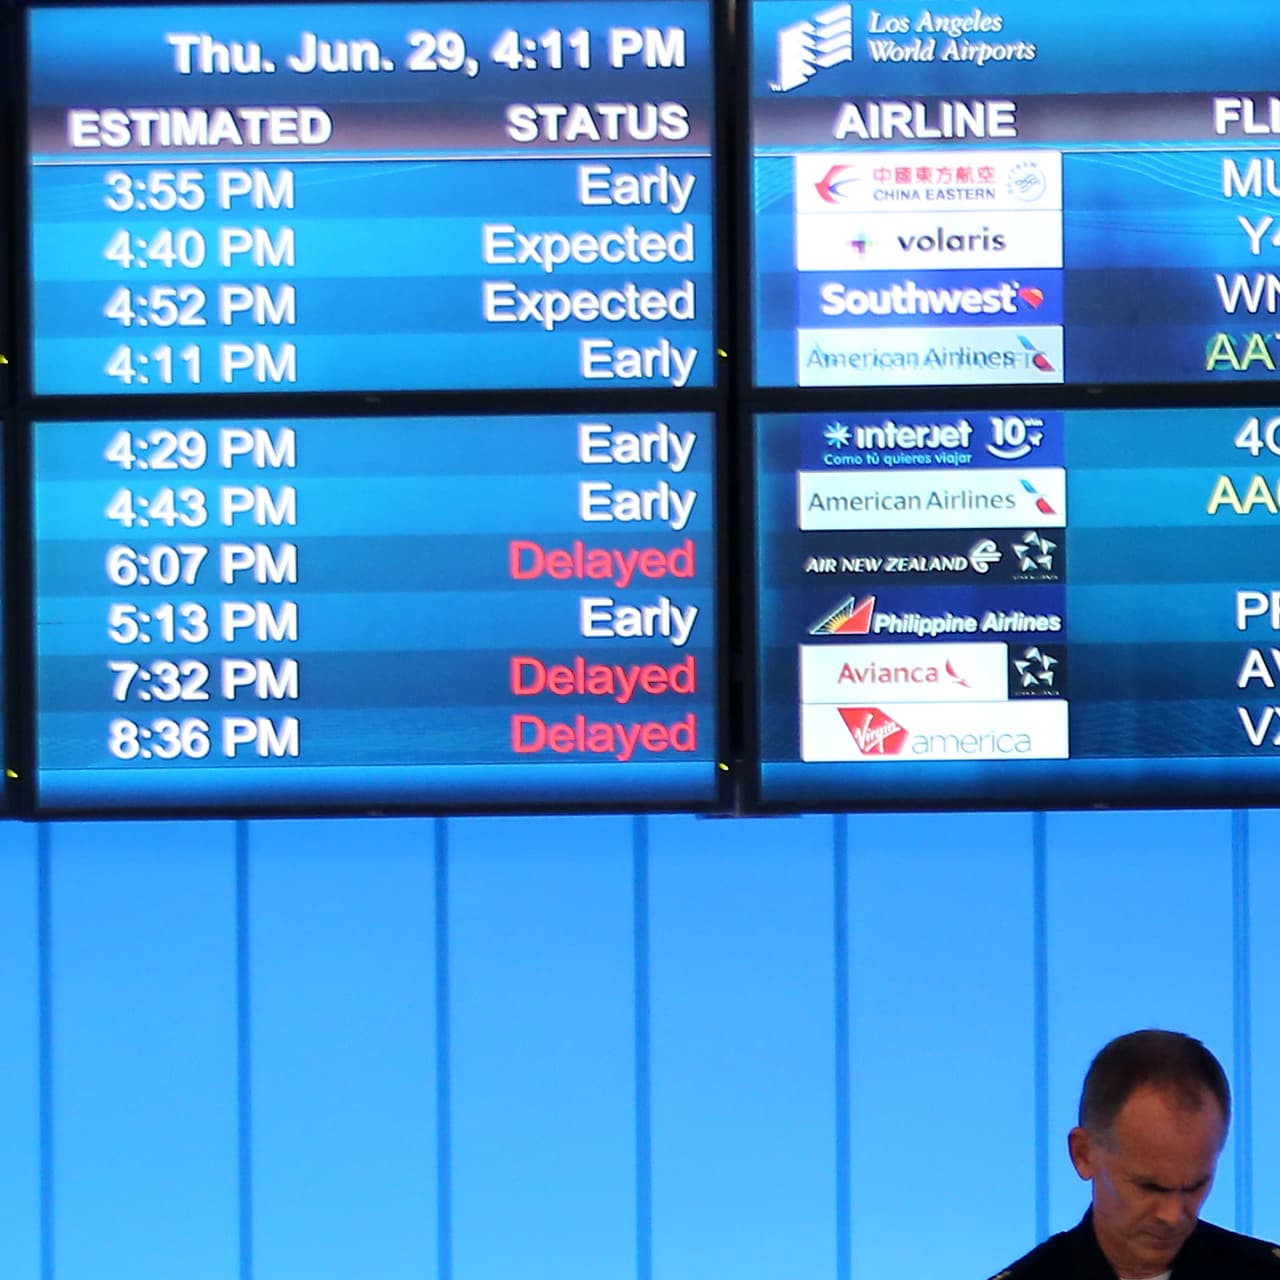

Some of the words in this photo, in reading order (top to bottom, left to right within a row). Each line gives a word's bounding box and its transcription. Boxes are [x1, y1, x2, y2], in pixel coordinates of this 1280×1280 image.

[867, 10, 910, 33] Los
[914, 7, 1003, 38] Angeles
[165, 32, 275, 74] Thu.
[287, 31, 394, 73] Jun.
[407, 29, 478, 77] 29,
[490, 28, 590, 69] 4:11
[609, 27, 685, 68] PM
[867, 37, 936, 62] World
[940, 38, 1036, 66] Airports
[67, 107, 332, 148] ESTIMATED
[505, 102, 689, 142] STATUS
[831, 101, 1017, 140] AIRLINE
[104, 169, 205, 212] 3:55
[218, 168, 294, 210] PM
[577, 164, 696, 214] Early
[873, 189, 920, 201] CHINA
[925, 188, 995, 201] EASTERN
[874, 165, 993, 184] 中國東方航空
[103, 228, 206, 269] 4:40
[219, 226, 295, 267] PM
[482, 222, 694, 273] Expected
[897, 226, 1006, 252] volaris
[103, 285, 206, 327] 4:52
[219, 284, 295, 325] PM
[483, 279, 695, 331] Expected
[820, 281, 1018, 315] Southwest
[105, 344, 200, 384] 4:11
[220, 342, 296, 383] PM
[580, 338, 698, 387] Early
[806, 345, 920, 369] American
[923, 347, 1016, 369] Airlines
[104, 429, 207, 470] 4:29
[219, 427, 295, 468] PM
[578, 422, 696, 472] Early
[823, 453, 863, 466] Como
[866, 452, 880, 466] tú
[883, 453, 932, 467] quieres
[935, 452, 973, 467] viajar
[105, 487, 208, 527] 4:43
[220, 485, 296, 526] PM
[579, 480, 697, 530] Early
[807, 491, 921, 511] American
[925, 490, 1016, 510] Airlines
[106, 544, 208, 586] 6:07
[220, 543, 297, 584] PM
[509, 539, 696, 589] Delayed
[805, 557, 837, 573] AIR
[841, 557, 883, 573] NEW
[884, 556, 968, 572] ZEALAND
[108, 602, 209, 644] 5:13
[221, 601, 297, 642] PM
[580, 596, 698, 646] Early
[874, 613, 977, 636] Philippine
[980, 611, 1061, 633] Airlines
[108, 660, 209, 701] 7:32
[221, 658, 298, 700] PM
[510, 655, 697, 704] Delayed
[837, 662, 939, 684] Avianca
[108, 717, 210, 759] 8:36
[222, 716, 299, 757] PM
[511, 712, 697, 762] Delayed
[855, 713, 900, 753] Virgin
[912, 731, 1031, 754] america
